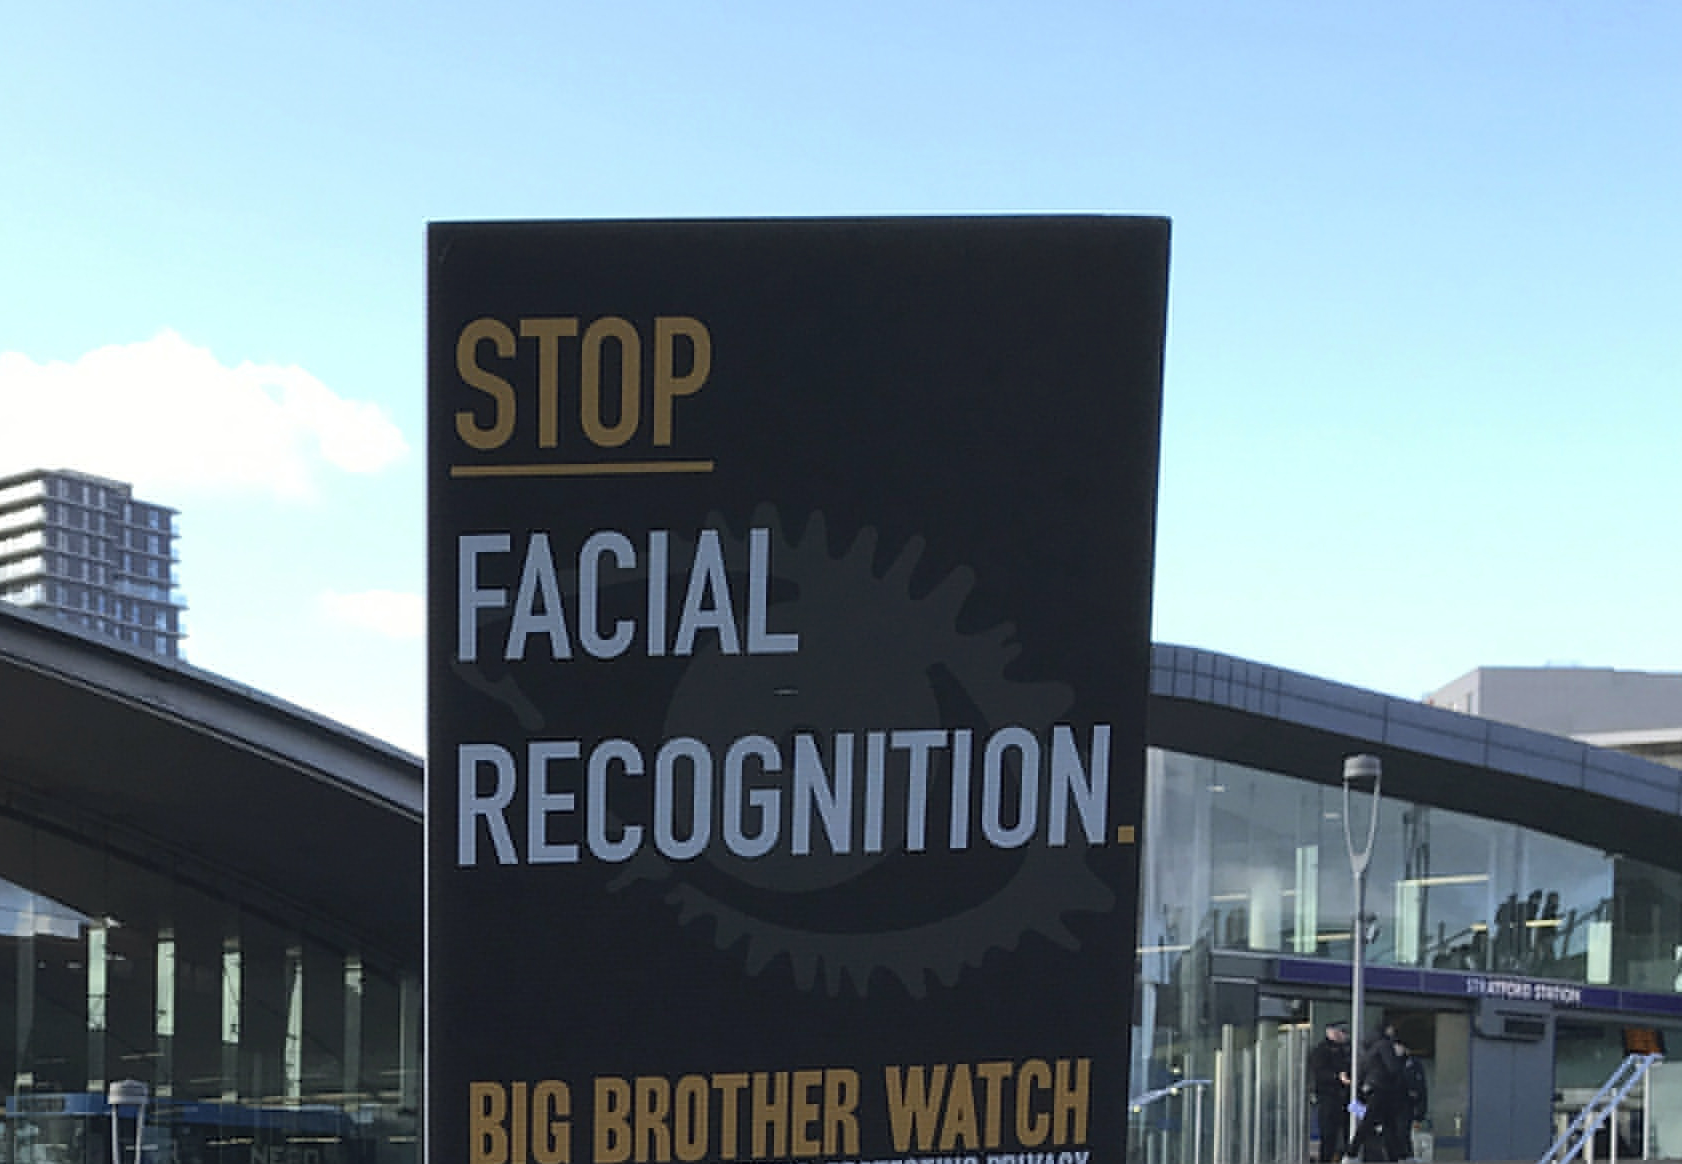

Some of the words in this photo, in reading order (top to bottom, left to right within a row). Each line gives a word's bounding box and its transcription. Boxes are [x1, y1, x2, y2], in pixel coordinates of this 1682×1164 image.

[455, 316, 712, 450] STOP
[456, 526, 800, 663] FACIAL
[456, 723, 1135, 867] RECOGNITION.
[594, 1069, 861, 1164] BROTHER
[885, 1057, 1091, 1153] WATCH
